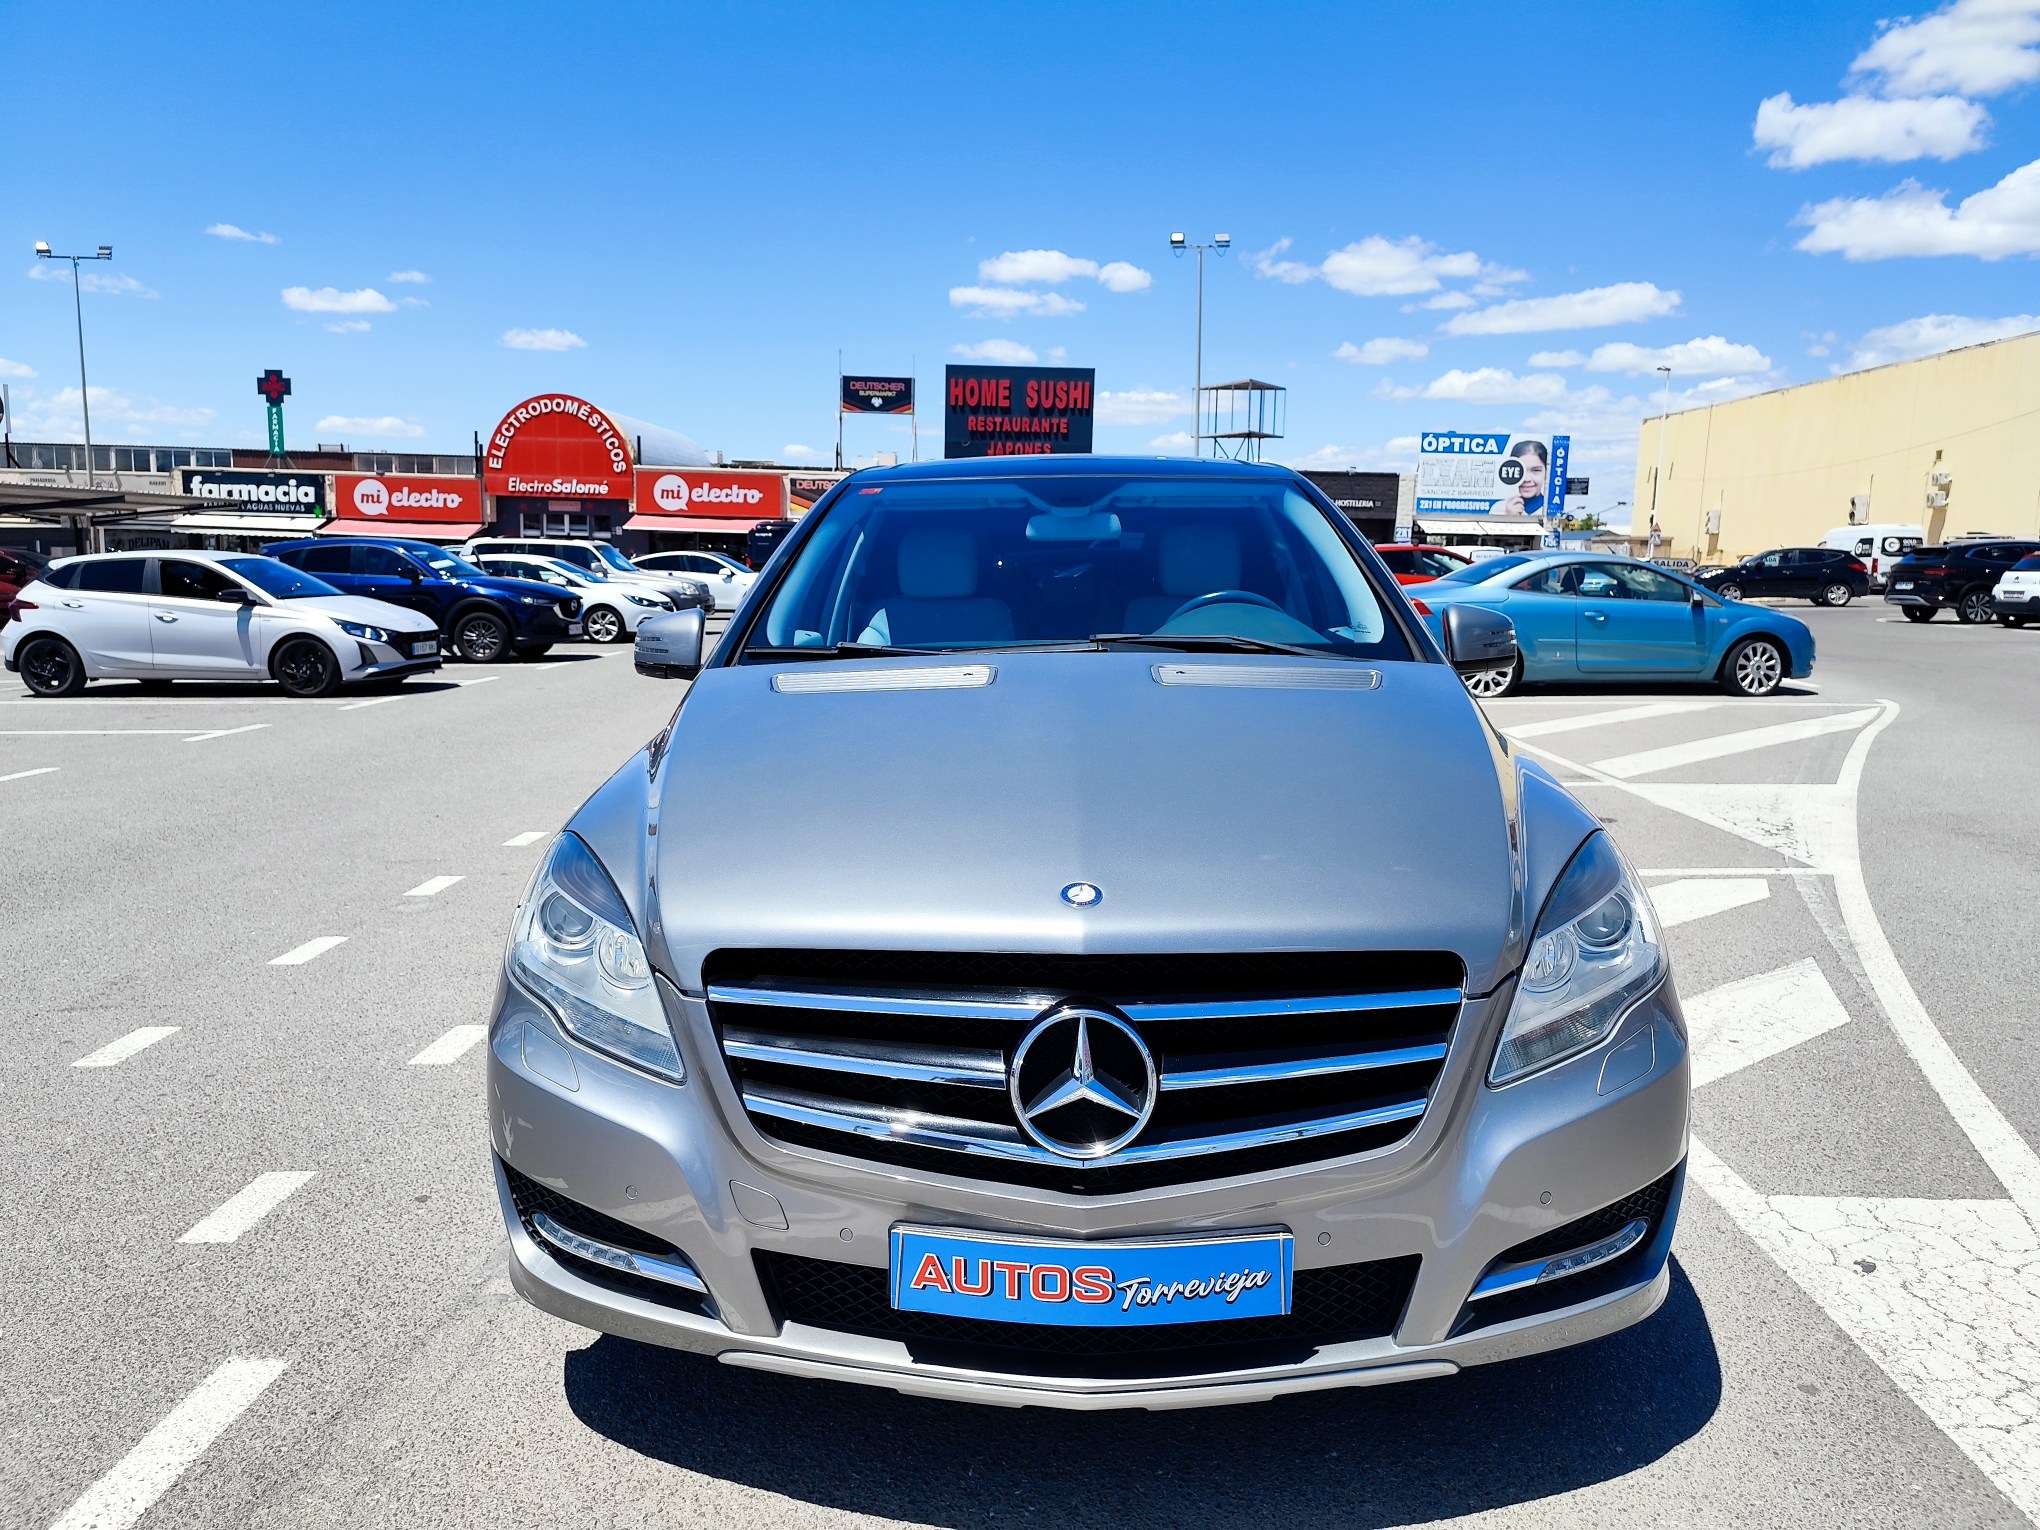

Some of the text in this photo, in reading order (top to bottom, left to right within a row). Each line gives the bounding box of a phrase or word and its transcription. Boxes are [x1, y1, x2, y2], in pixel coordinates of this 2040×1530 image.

[850, 381, 905, 391] DEUTSCHER
[949, 378, 1091, 410] HOME SUSHI
[271, 407, 280, 453] FARMACIA
[488, 398, 627, 473] ELECTRODOMÉSTICOS
[967, 416, 1069, 434] RESTAURANTE
[1422, 433, 1500, 453] ÓPTICA
[1501, 466, 1521, 478] EYE
[190, 475, 316, 503] farmacia
[360, 489, 383, 504] mi
[391, 486, 463, 509] electro
[660, 485, 683, 500] mi
[691, 482, 763, 504] electro
[246, 504, 305, 512] AGUAS NUEVAS
[910, 1252, 1272, 1311] AUTOS Torrevieja
